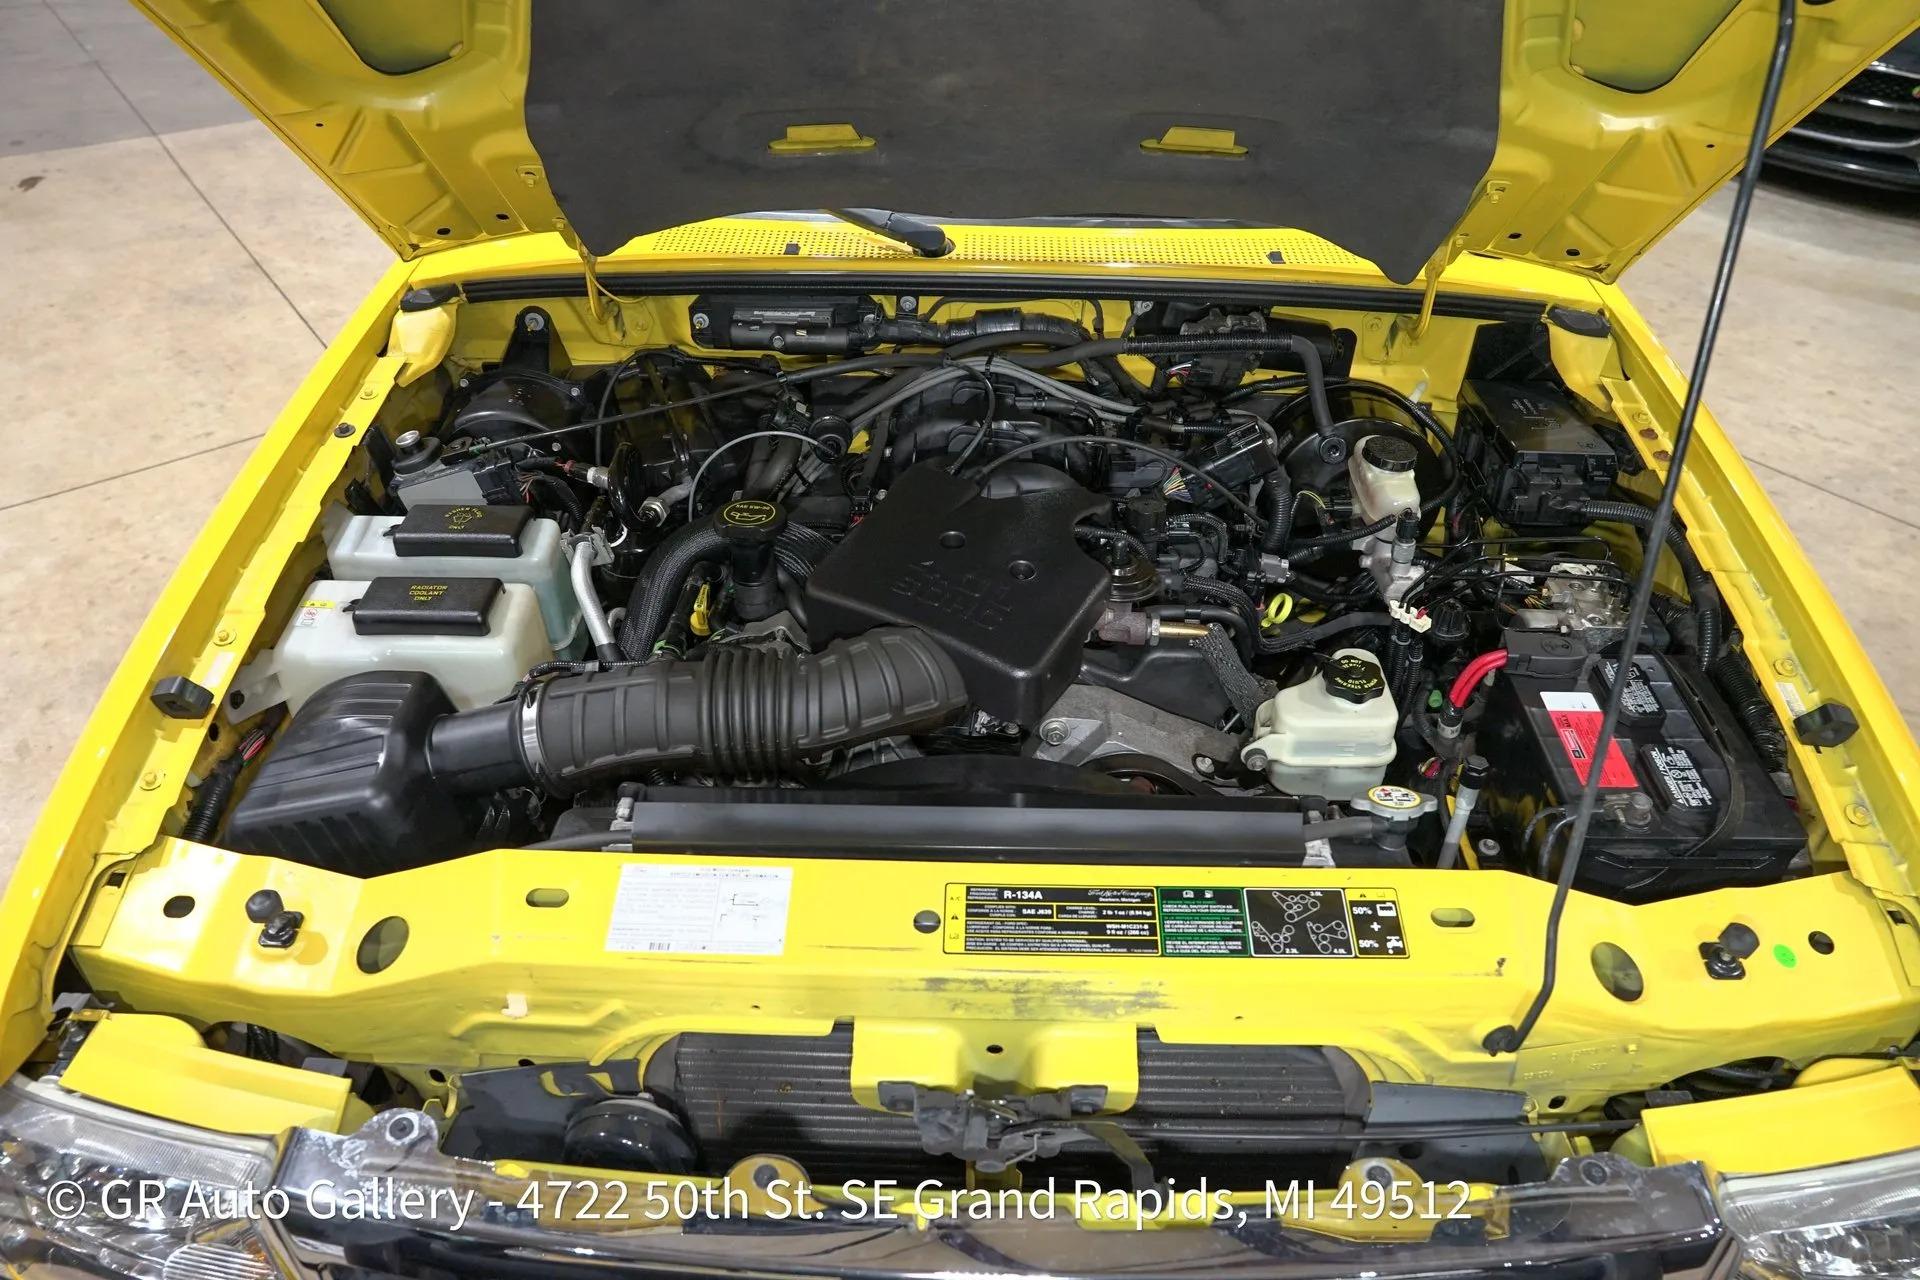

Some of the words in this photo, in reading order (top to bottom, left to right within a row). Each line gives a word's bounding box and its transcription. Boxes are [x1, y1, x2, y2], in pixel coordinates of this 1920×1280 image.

[1003, 890, 1043, 900] R-134A
[1352, 906, 1373, 915] 50%
[1358, 940, 1379, 948] 50%
